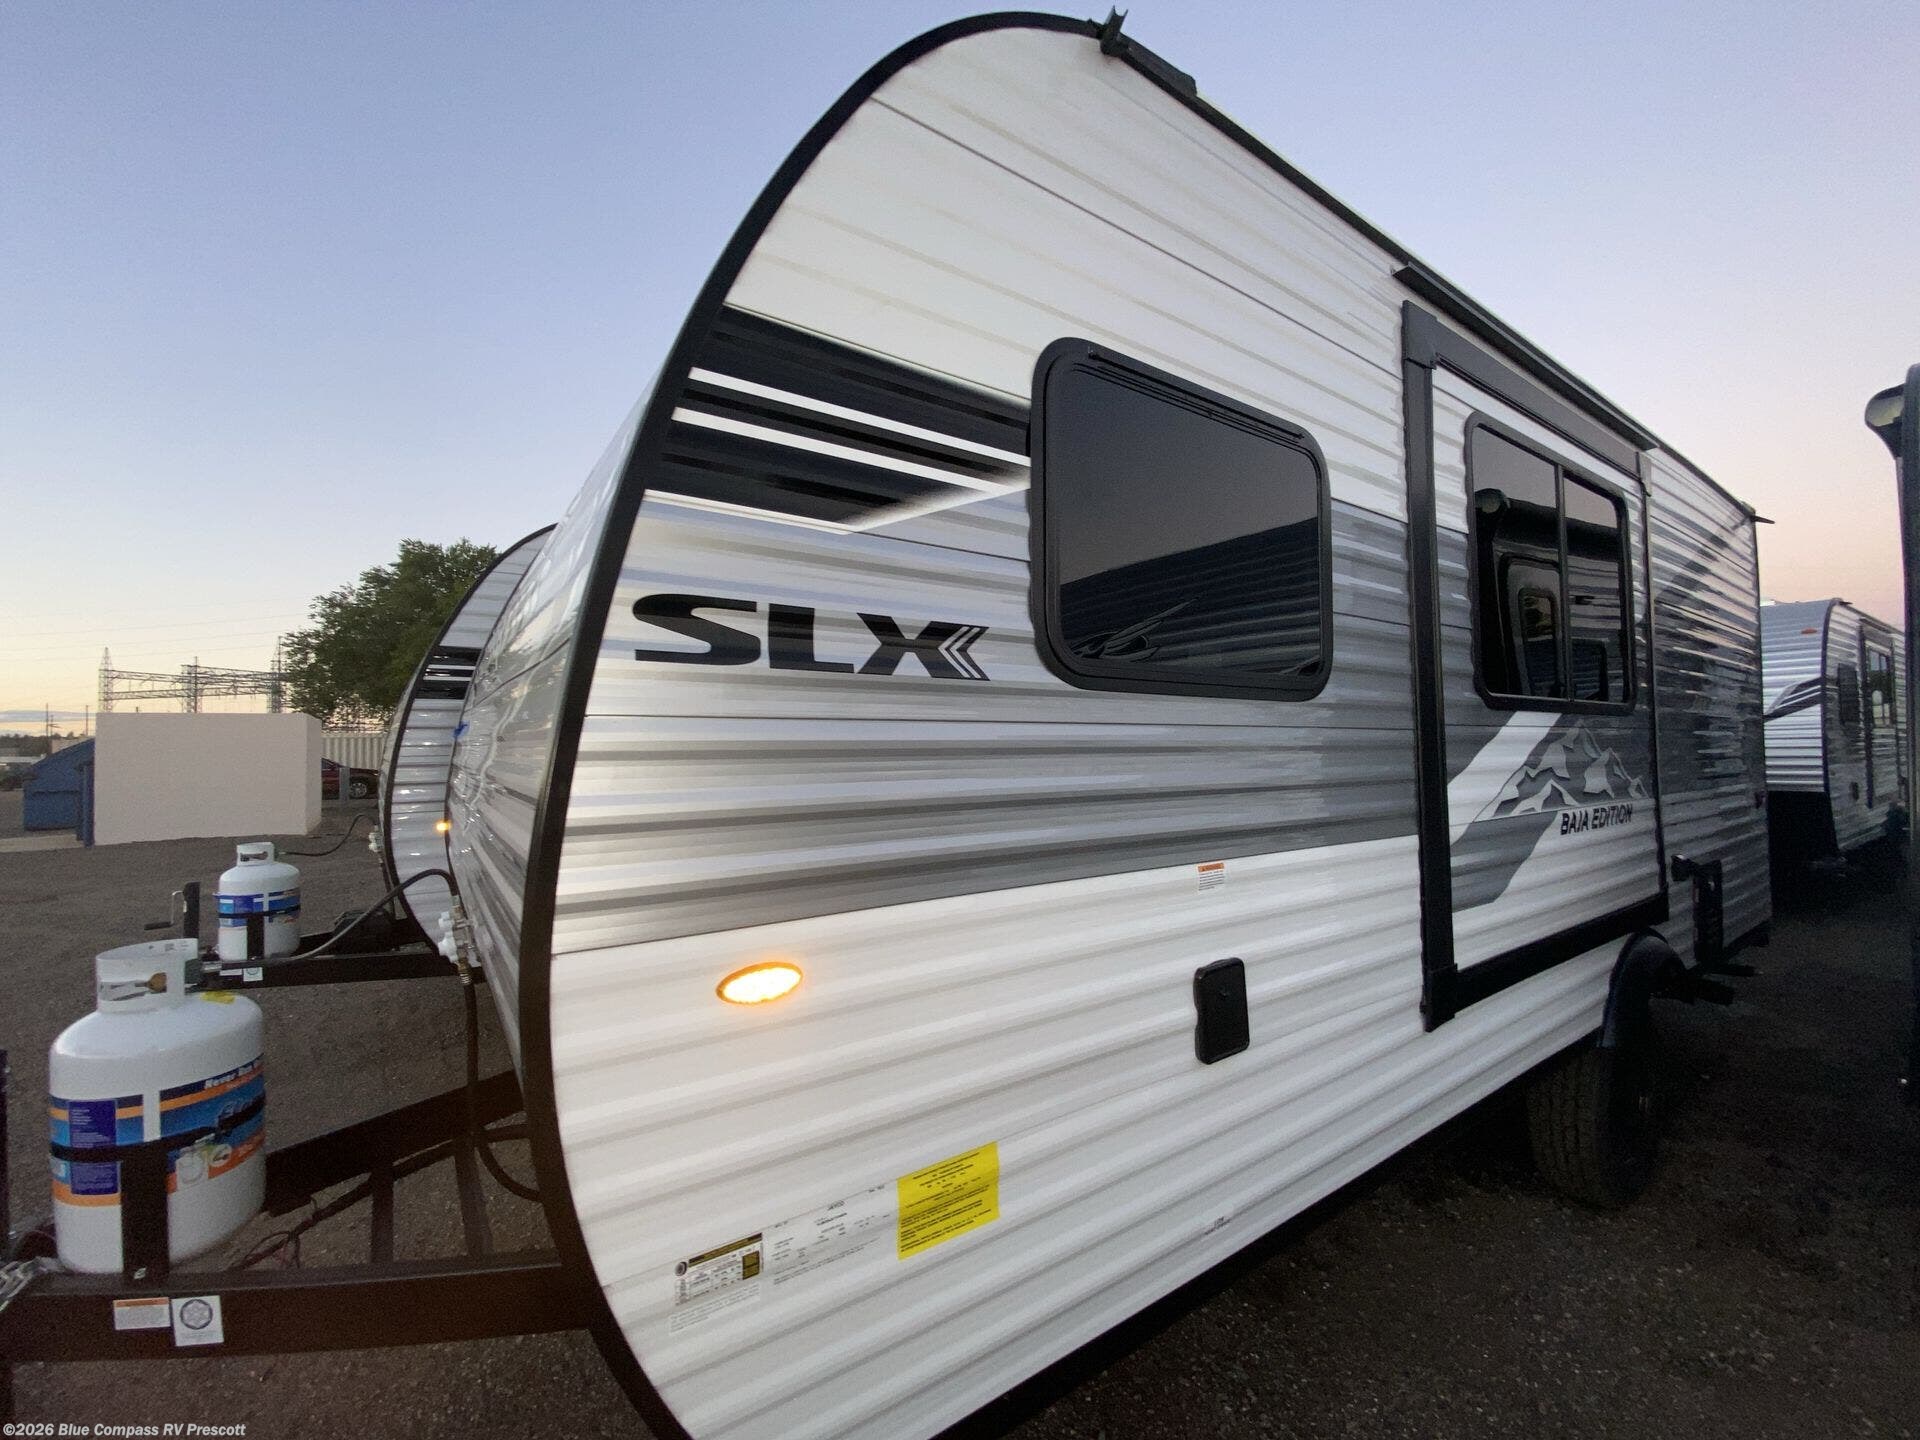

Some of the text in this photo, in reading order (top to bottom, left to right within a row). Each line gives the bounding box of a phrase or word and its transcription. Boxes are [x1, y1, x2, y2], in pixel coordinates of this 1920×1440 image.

[632, 593, 990, 681] SLX
[1561, 803, 1633, 835] BAJA EDITION
